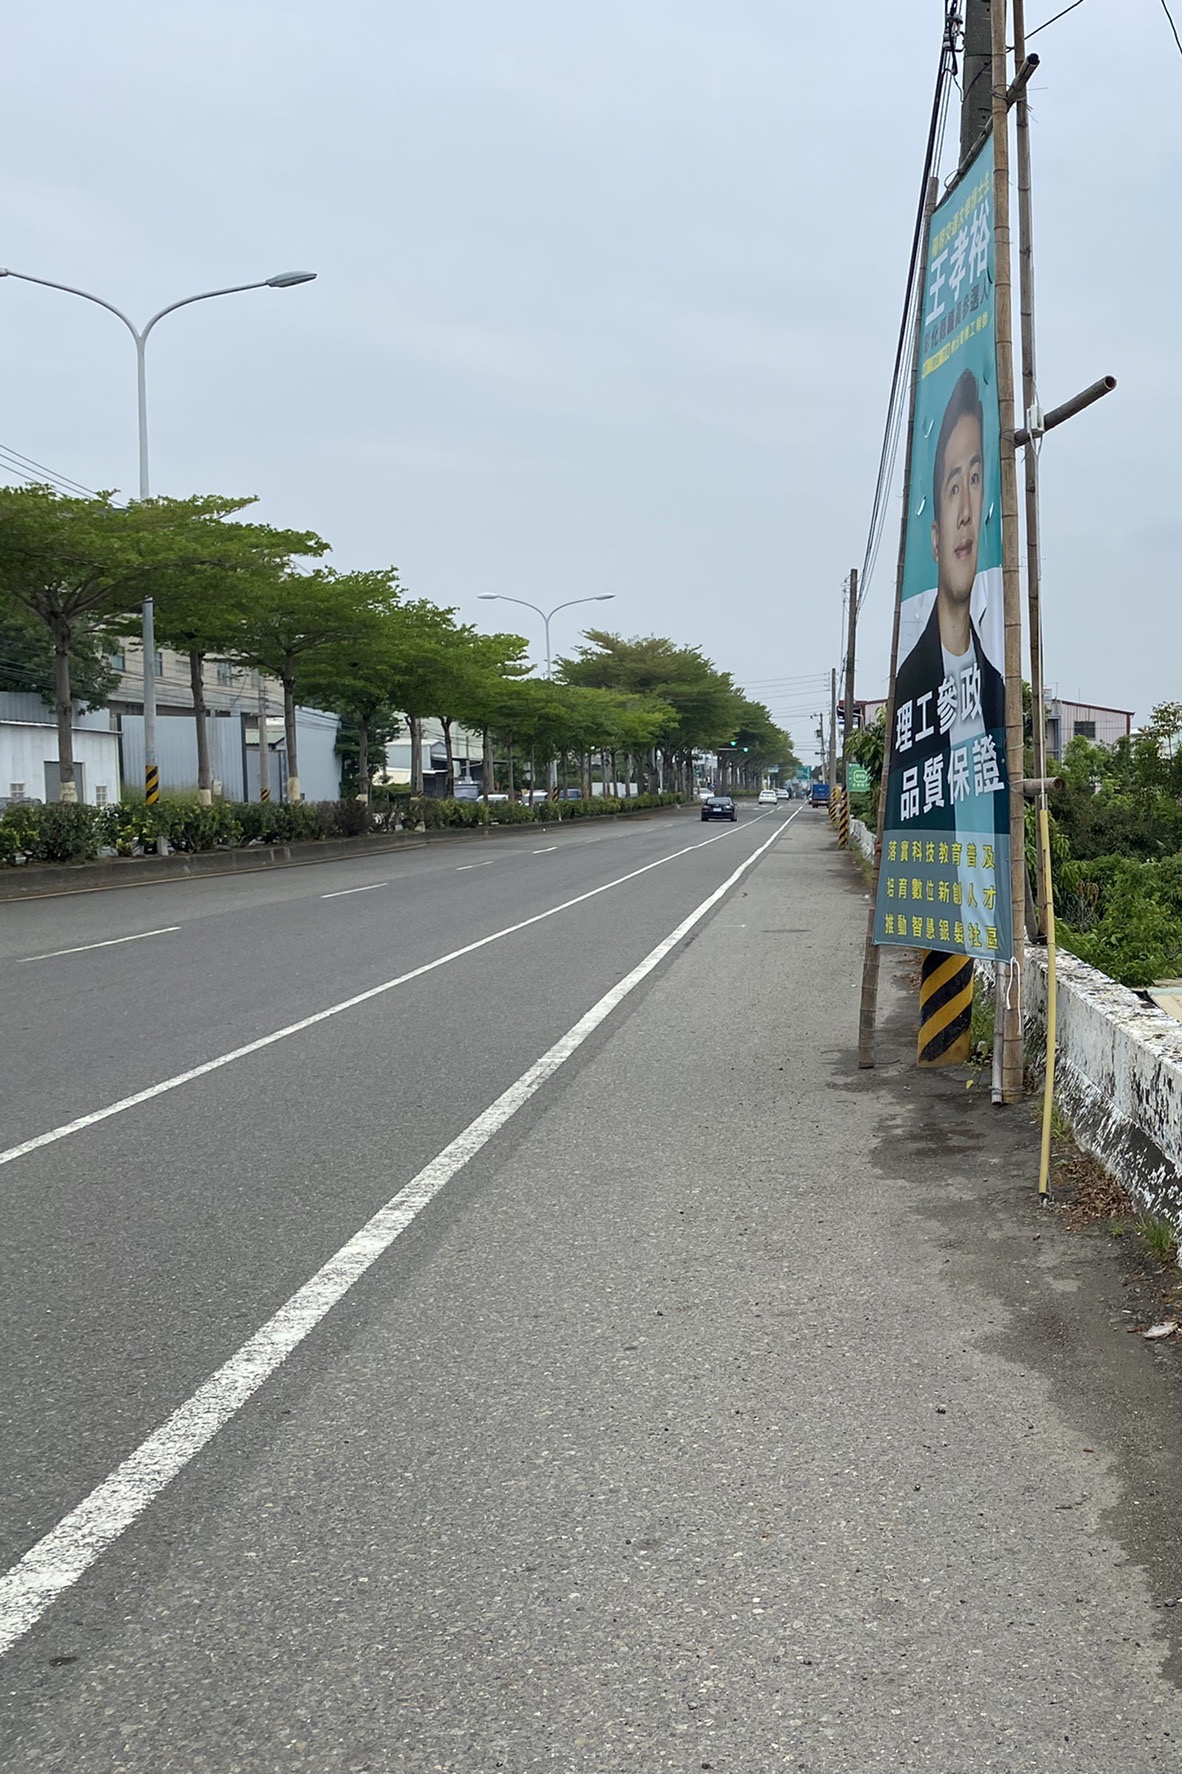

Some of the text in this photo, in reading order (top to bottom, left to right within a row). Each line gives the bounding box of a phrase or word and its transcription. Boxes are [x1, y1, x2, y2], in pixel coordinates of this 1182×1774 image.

[895, 662, 983, 753] 理工參政
[900, 734, 1005, 822] 品質保證
[888, 840, 996, 870] 落實科技教育普及
[886, 876, 997, 910] 培育數位新創人才
[884, 912, 999, 950] 推動智慧銀髮社區
